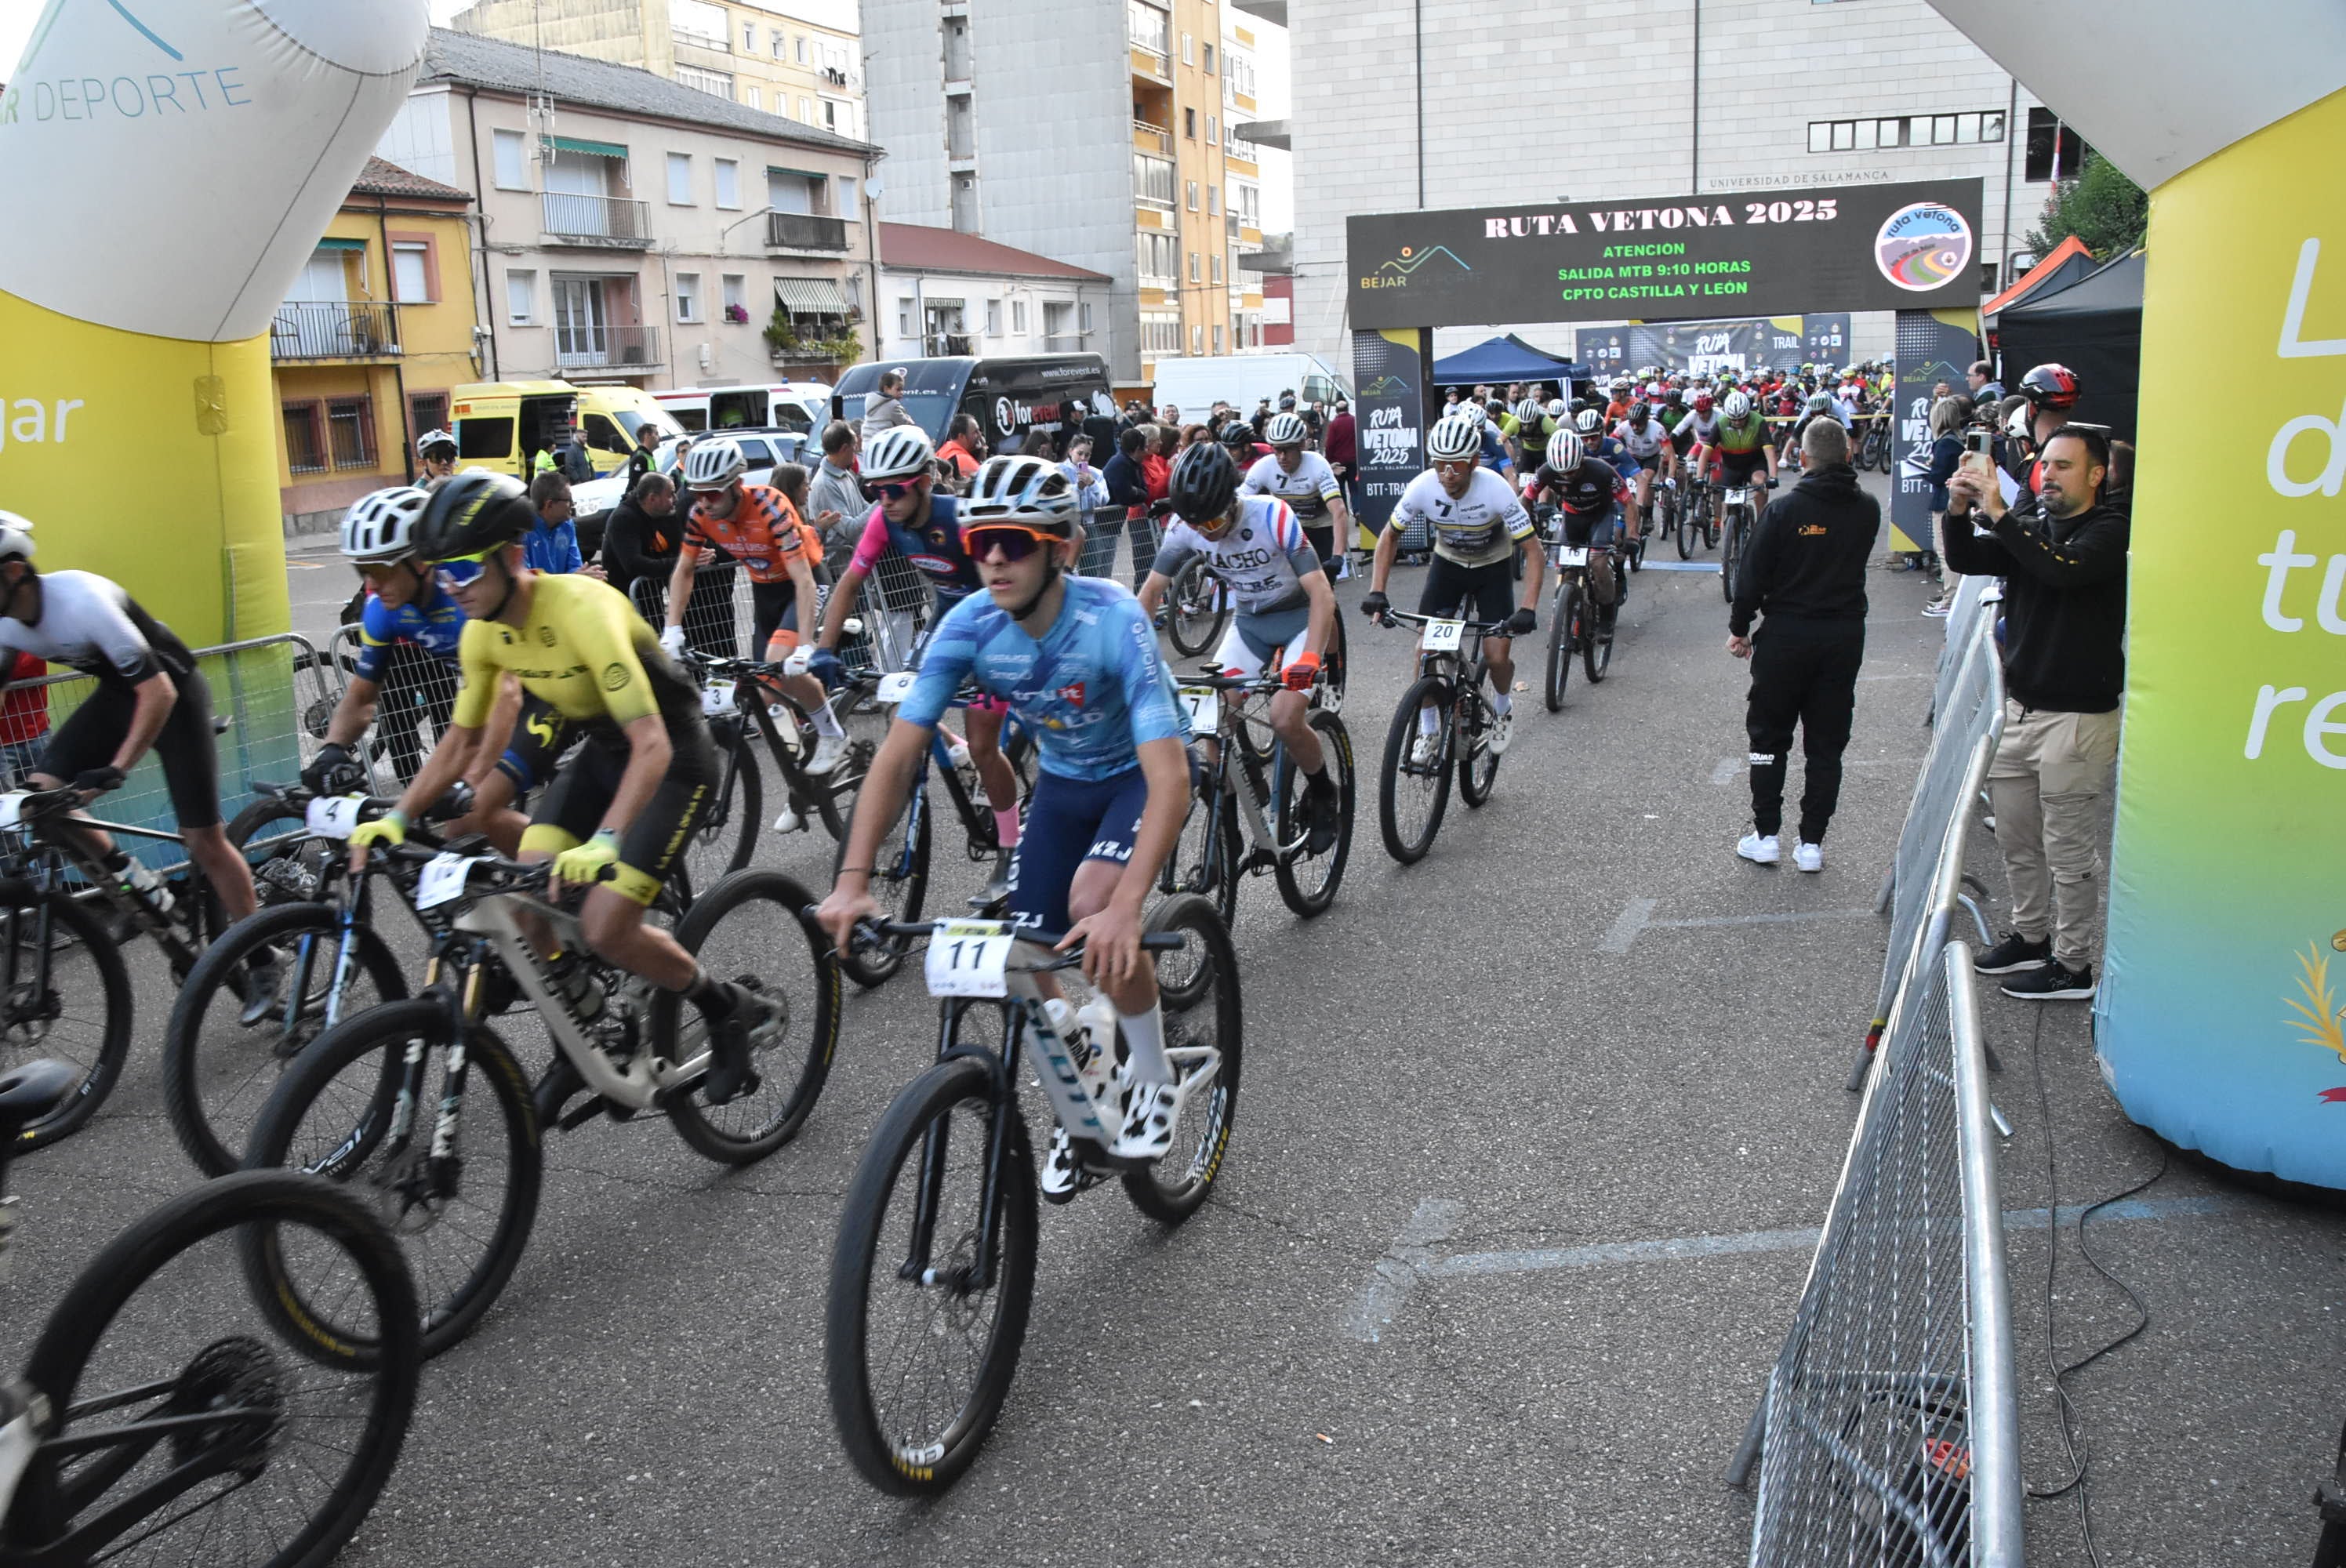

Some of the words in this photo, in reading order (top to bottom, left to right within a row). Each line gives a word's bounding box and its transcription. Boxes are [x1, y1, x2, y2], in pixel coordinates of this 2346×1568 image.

[34, 67, 252, 122] DEPORTE
[1710, 175, 1790, 188] UNIVERSIDAD
[1793, 174, 1808, 183] DE
[1812, 170, 1889, 183] SALAMANCA
[1484, 214, 1578, 238] RUTA
[1589, 205, 1735, 233] VETONA
[1745, 198, 1838, 224] 2025
[1887, 215, 1912, 238] ruta
[1914, 209, 1961, 234] vetona
[1360, 270, 1407, 289] BÉJAR
[1558, 267, 1614, 281] SALIDA
[1618, 265, 1652, 278] MTB
[1657, 263, 1690, 276] 9:10
[1694, 260, 1751, 274] HORAS
[1562, 288, 1604, 300] CPTO
[1607, 284, 1685, 299] CASTILLA
[1688, 283, 1700, 296] Y
[1704, 279, 1748, 296] LEÓN
[1695, 332, 1730, 355] RUTA
[1772, 336, 1800, 350] TRAIL
[1014, 400, 1062, 425] forevent
[1369, 405, 1403, 429] RUTA
[0, 397, 85, 453] ar
[1363, 427, 1418, 449] VETONA
[1369, 448, 1410, 465] 2025
[1276, 474, 1289, 489] 7
[1435, 499, 1452, 517] 7
[1433, 625, 1454, 638] 20
[712, 688, 722, 705] 3
[1189, 697, 1201, 717] 7
[1749, 752, 1775, 761] SQUAD
[324, 801, 340, 821] 4
[949, 939, 990, 970] 11
